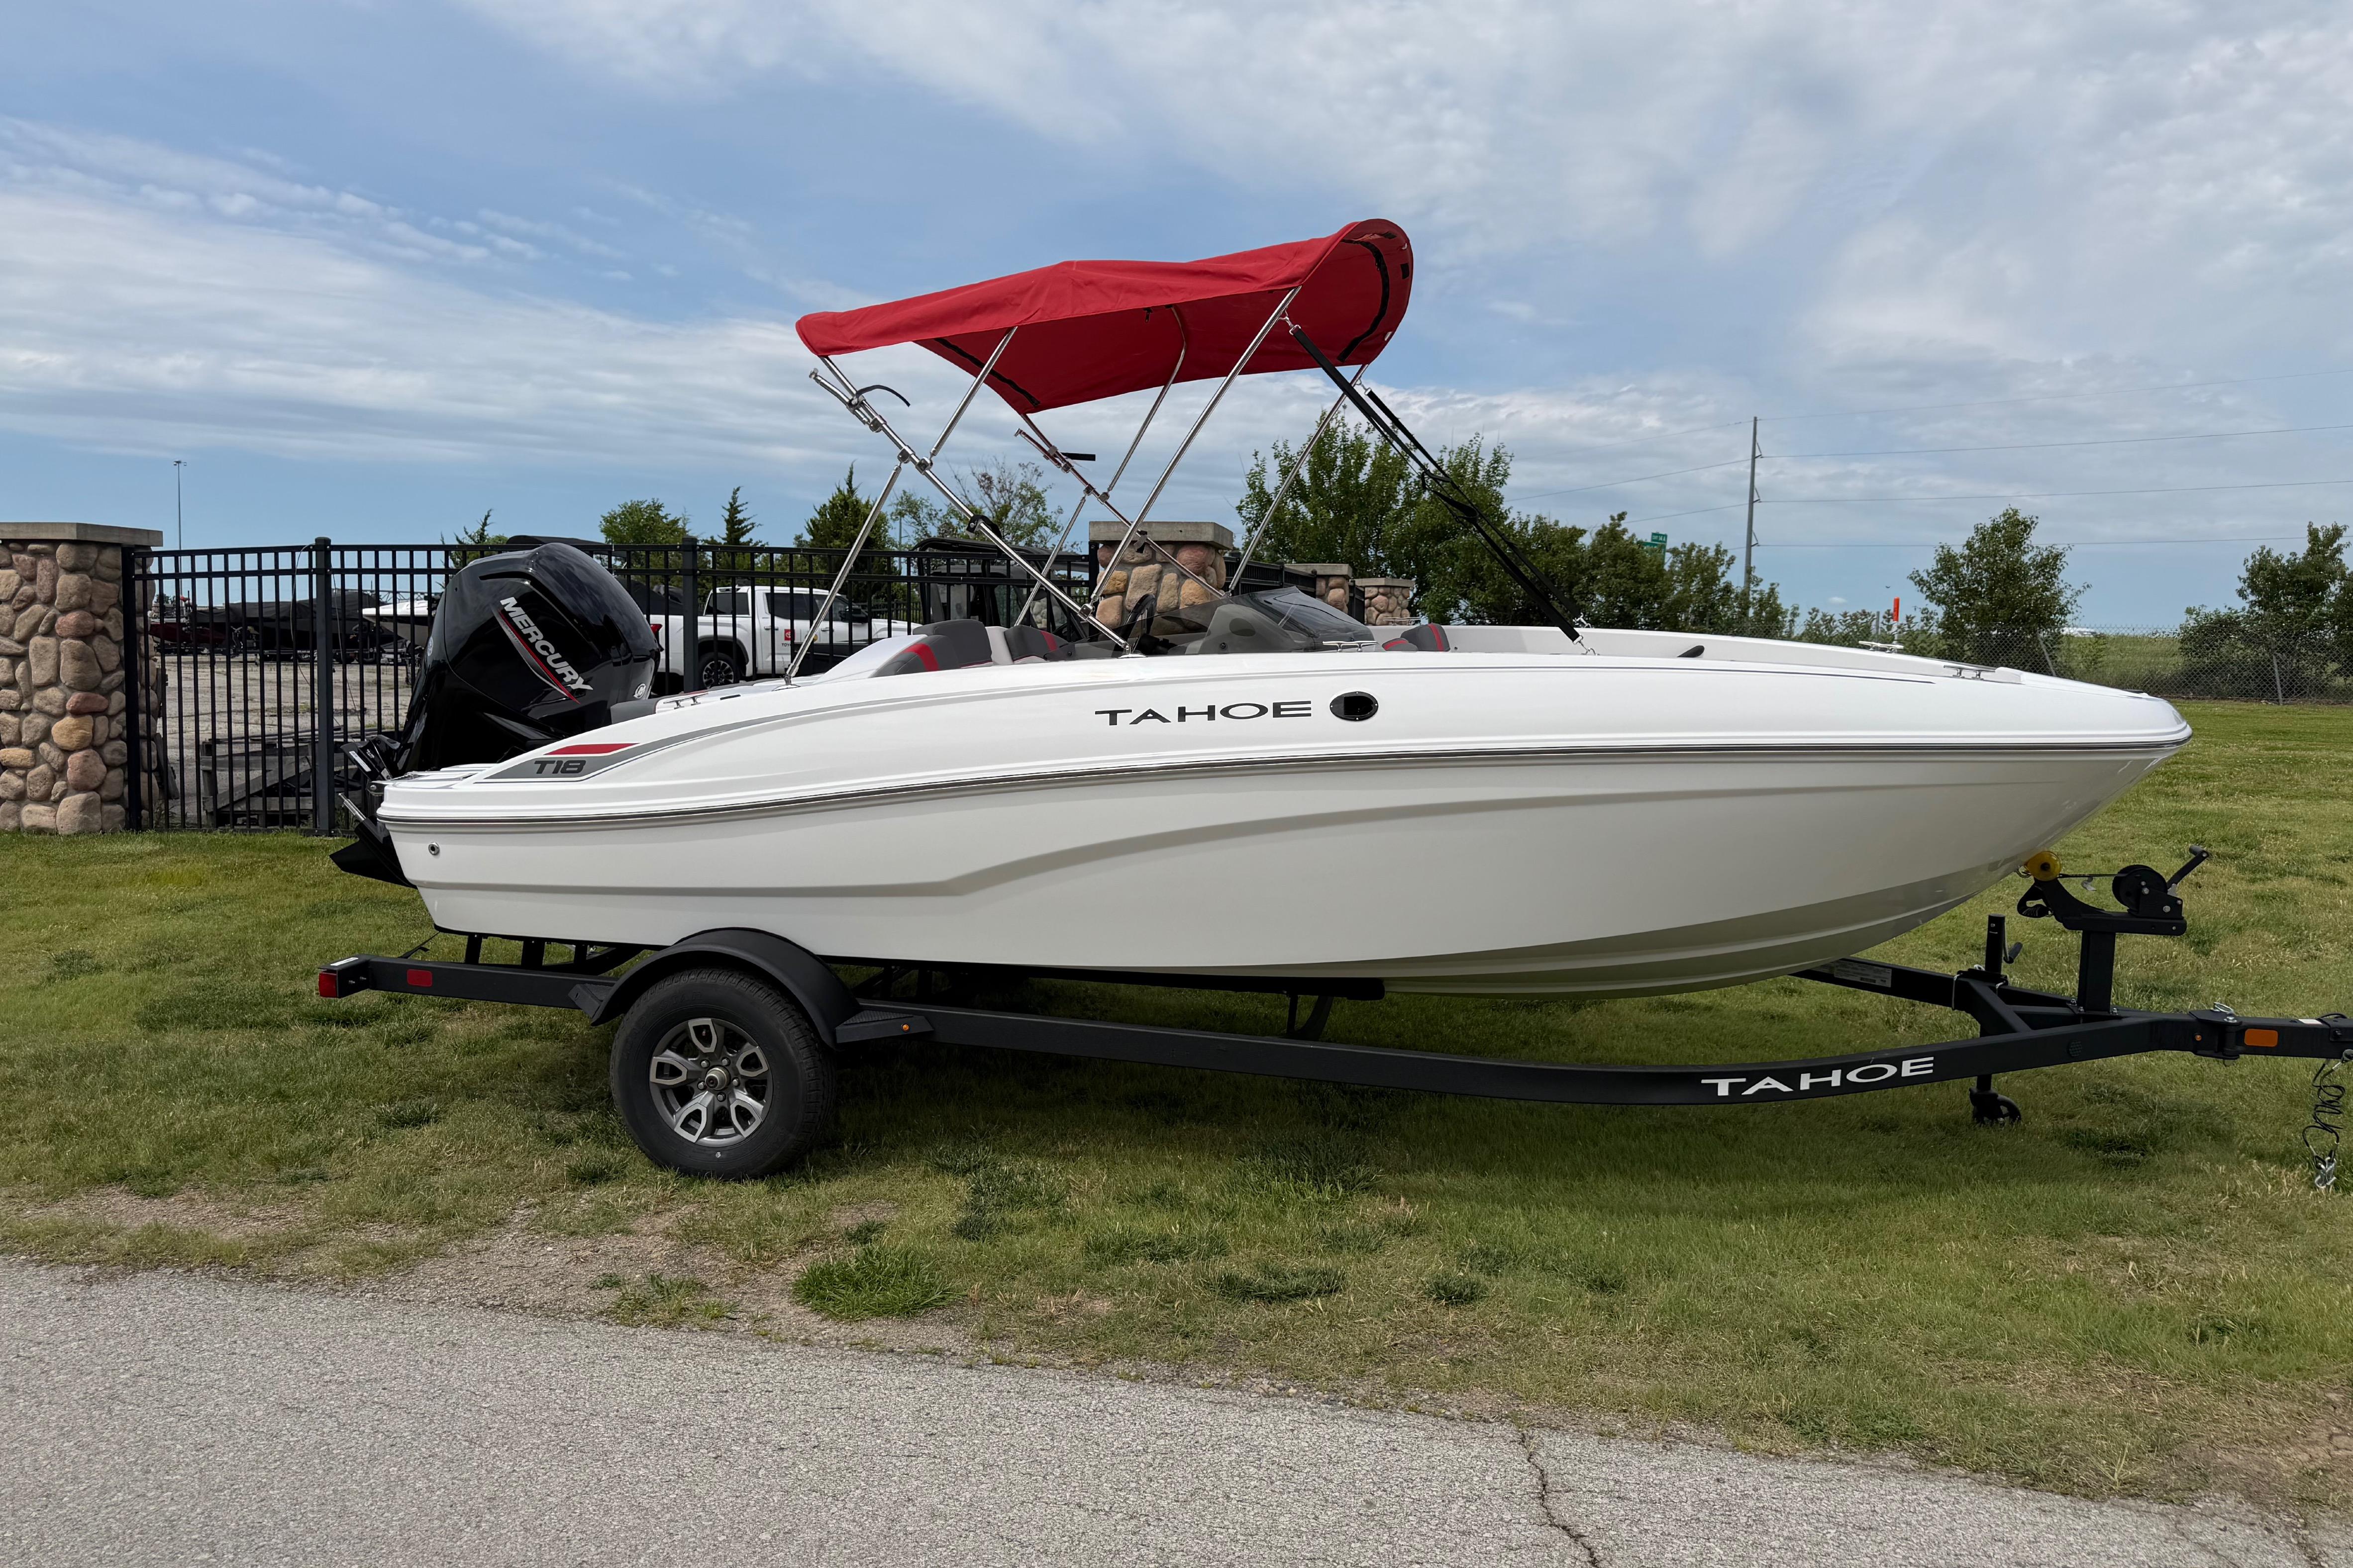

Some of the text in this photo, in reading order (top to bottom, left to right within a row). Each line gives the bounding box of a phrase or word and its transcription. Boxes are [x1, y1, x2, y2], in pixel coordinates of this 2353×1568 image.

[500, 596, 594, 690] MERCURY
[1095, 700, 1312, 726] TAHOE
[534, 760, 587, 774] T18
[1701, 1057, 1935, 1096] TAHOE
